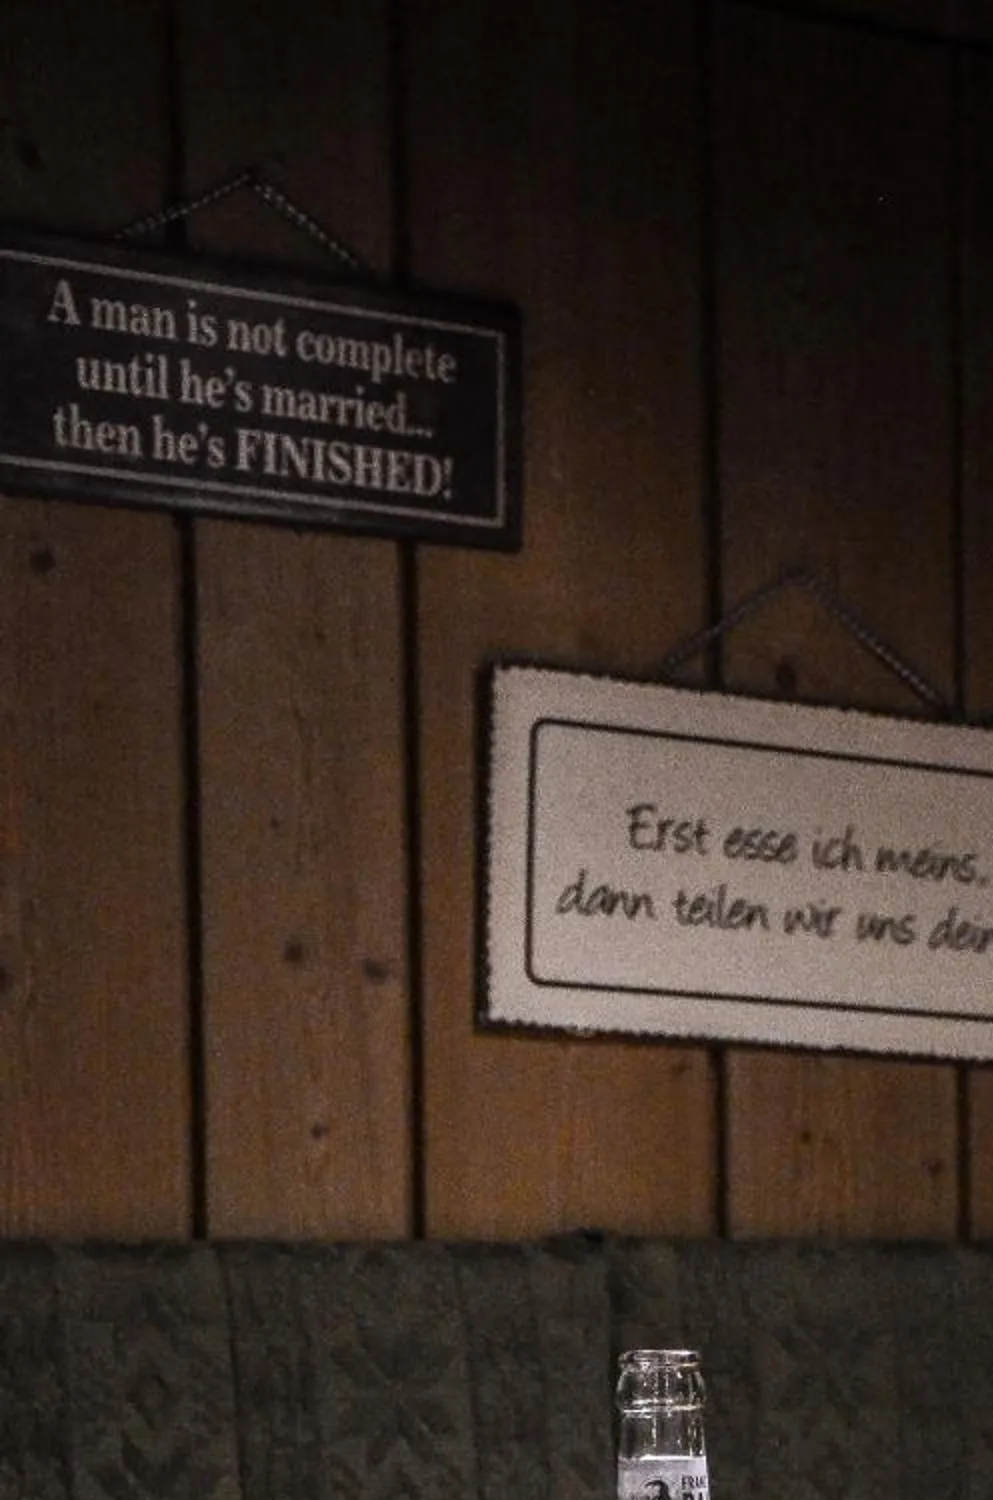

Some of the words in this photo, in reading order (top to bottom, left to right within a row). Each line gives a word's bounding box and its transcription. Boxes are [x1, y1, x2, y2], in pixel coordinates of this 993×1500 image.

[47, 278, 80, 326] A
[90, 297, 176, 342] man
[187, 299, 218, 348] is
[227, 315, 288, 357] not
[298, 332, 457, 384] complete
[76, 352, 169, 399] until
[180, 357, 253, 412] he's
[52, 402, 142, 458] then
[152, 414, 225, 468] he's
[235, 428, 454, 499] FINISHED!
[626, 803, 710, 856] Erst
[722, 824, 799, 863] esse
[811, 826, 863, 873] ich
[555, 868, 656, 922] dann
[674, 883, 770, 931] teilen
[783, 903, 842, 940] wir
[856, 911, 916, 946] uns
